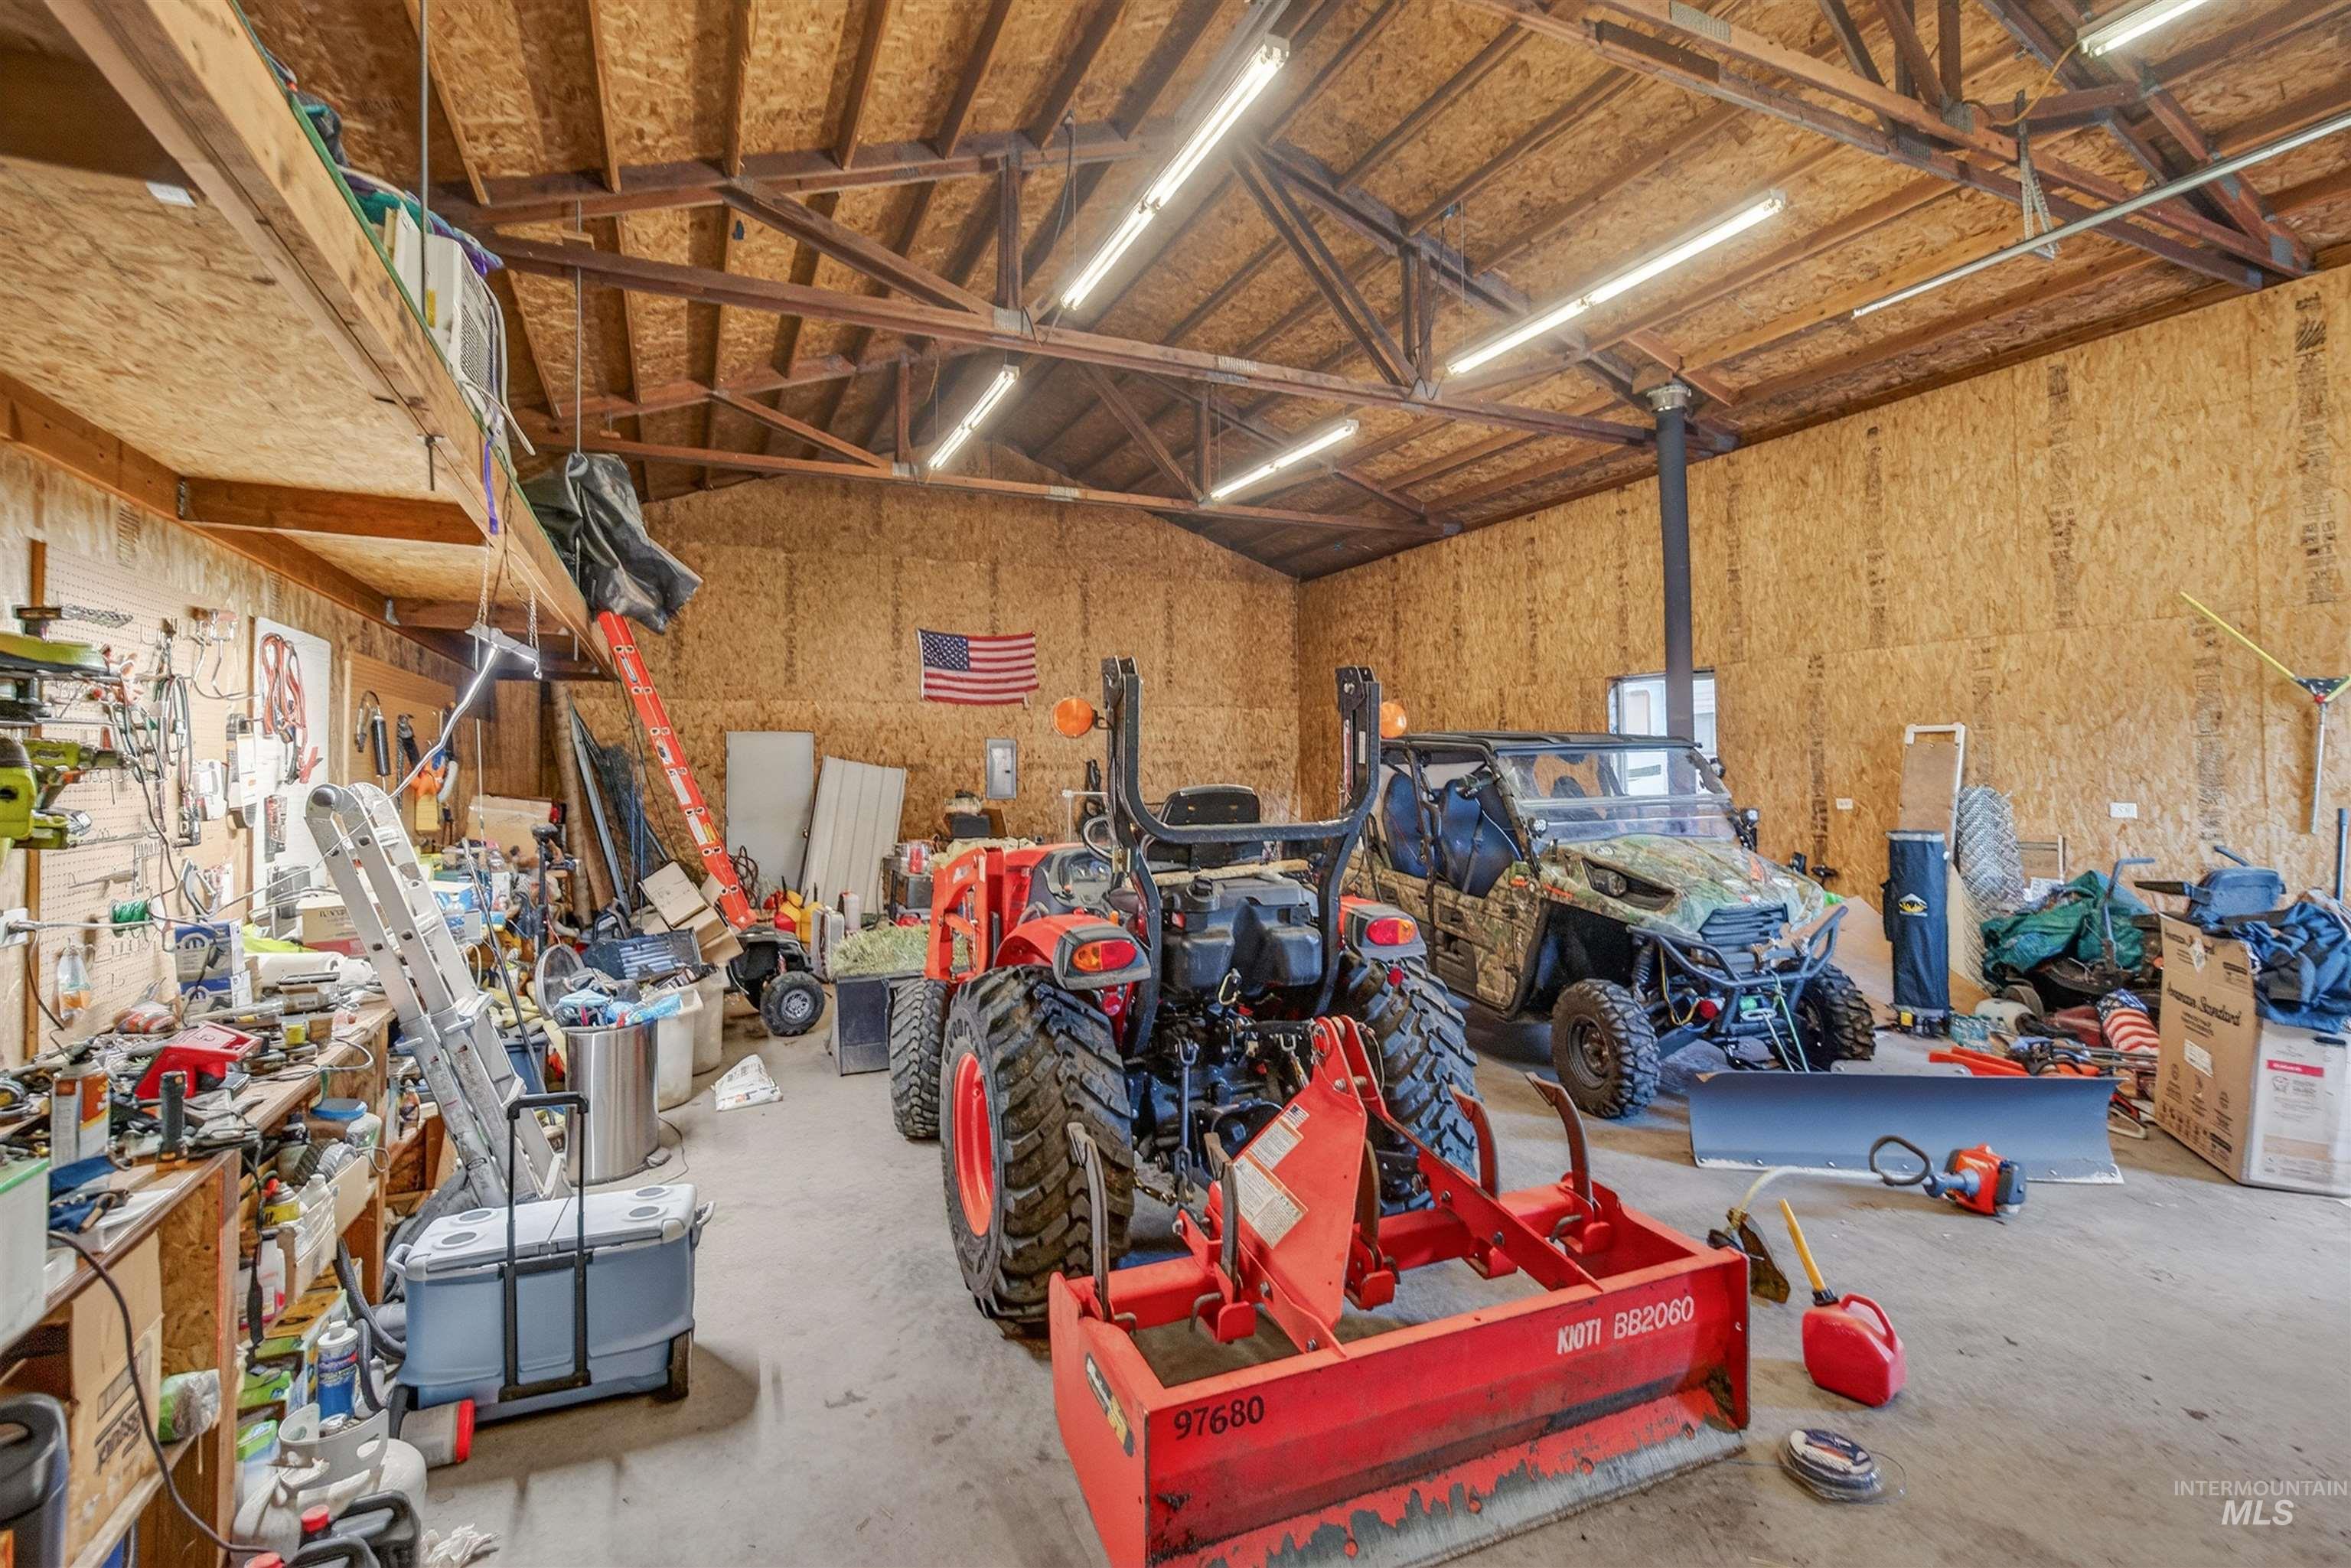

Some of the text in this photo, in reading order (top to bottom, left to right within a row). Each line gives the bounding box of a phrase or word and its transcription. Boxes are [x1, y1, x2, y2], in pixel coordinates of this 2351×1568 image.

[1557, 1296, 1695, 1354] KIOTI BB2060
[1173, 1395, 1265, 1440] 97680
